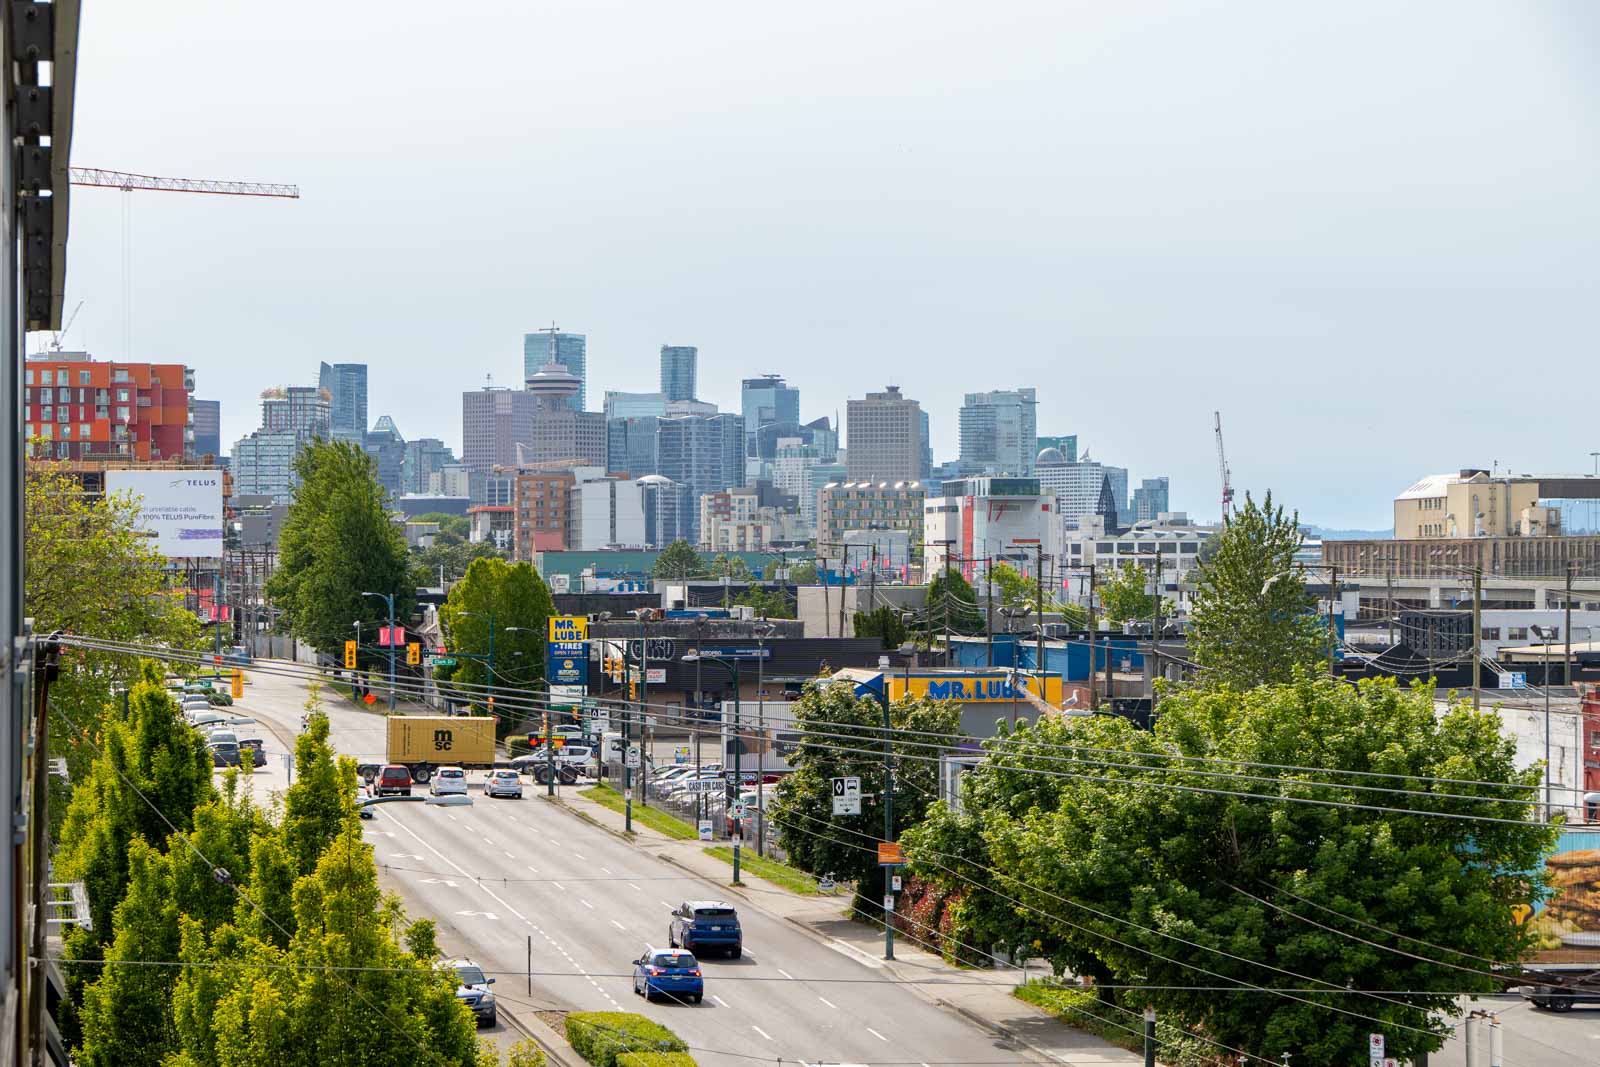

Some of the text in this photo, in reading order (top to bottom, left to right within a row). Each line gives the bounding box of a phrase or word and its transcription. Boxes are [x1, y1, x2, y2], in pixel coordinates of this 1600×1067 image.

[555, 620, 577, 629] MR.
[554, 631, 583, 640] LUBE
[929, 681, 972, 699] MR.
[688, 781, 725, 791] CASH FOR CARS
